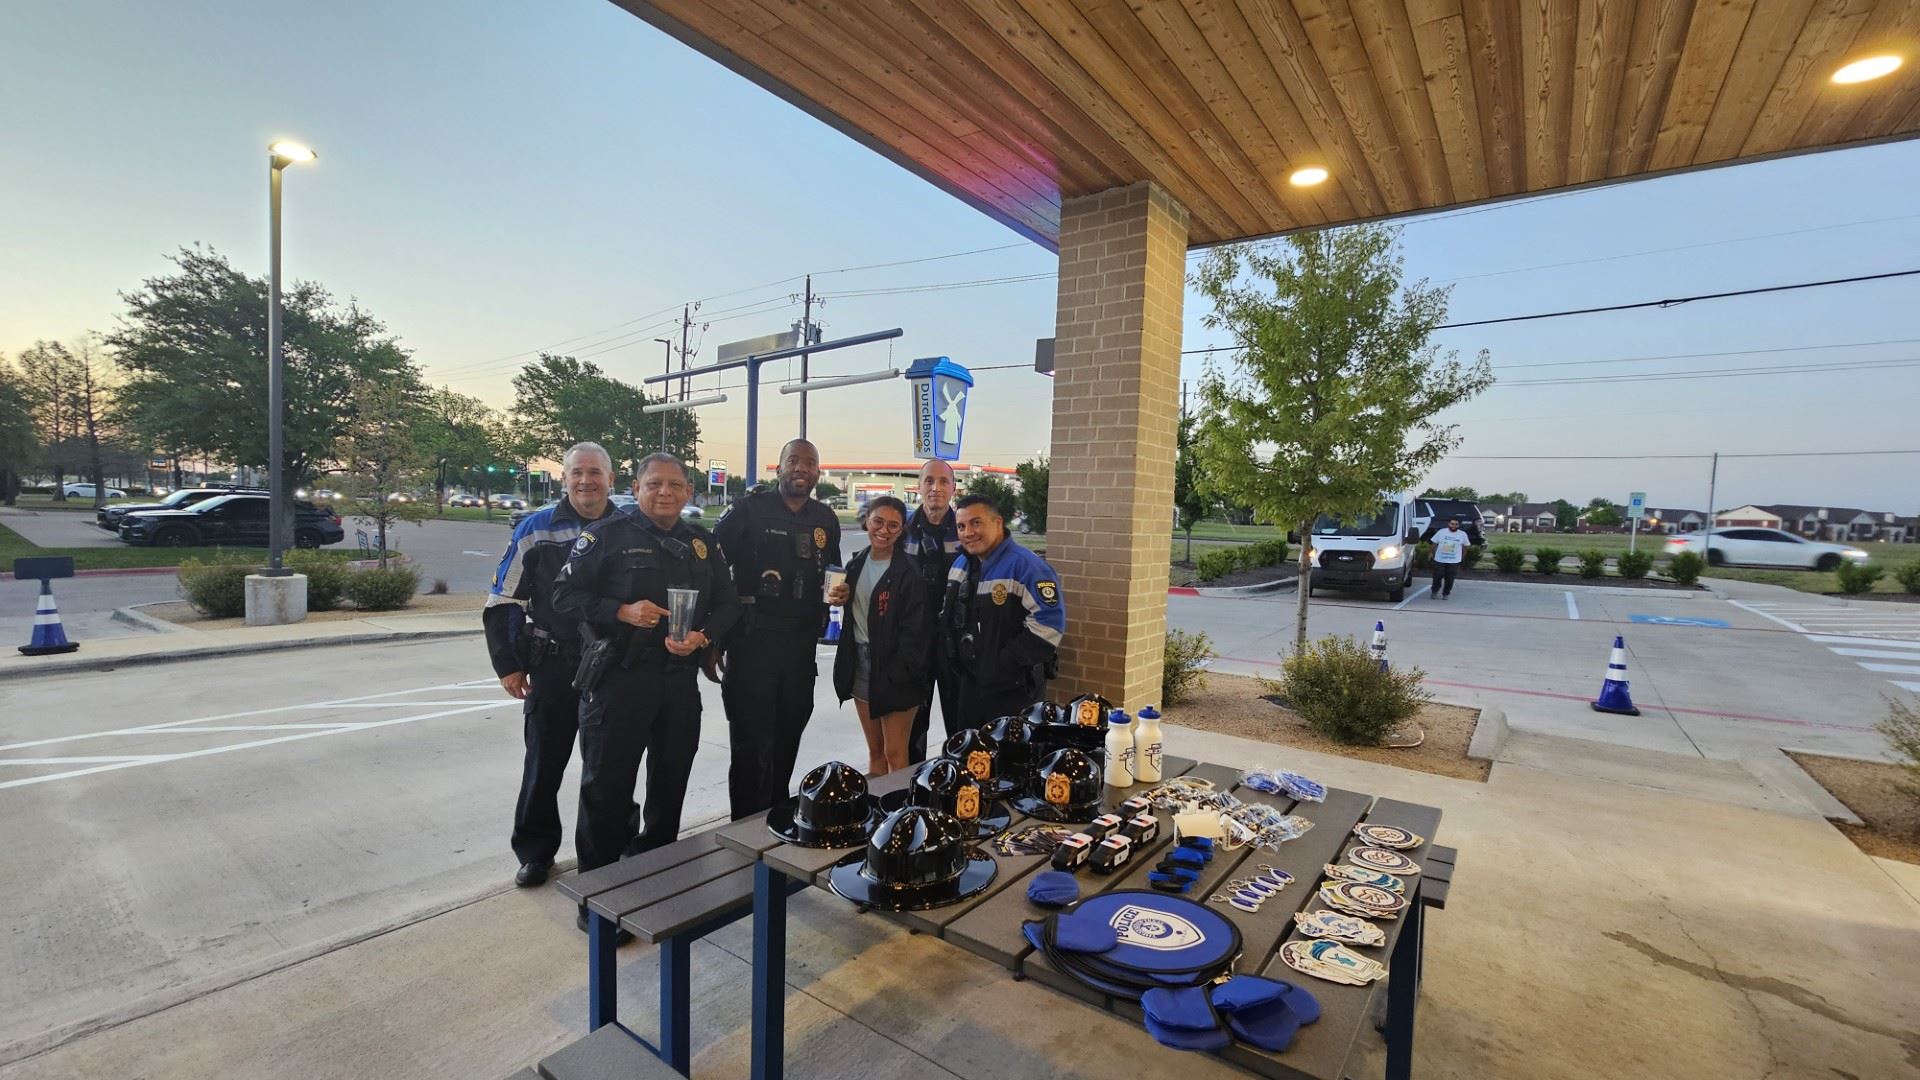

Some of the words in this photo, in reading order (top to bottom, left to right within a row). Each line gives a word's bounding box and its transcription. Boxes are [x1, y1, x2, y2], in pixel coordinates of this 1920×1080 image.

[921, 383, 931, 422] DUTCH
[922, 423, 932, 453] BROS
[1116, 909, 1140, 938] POLICE
